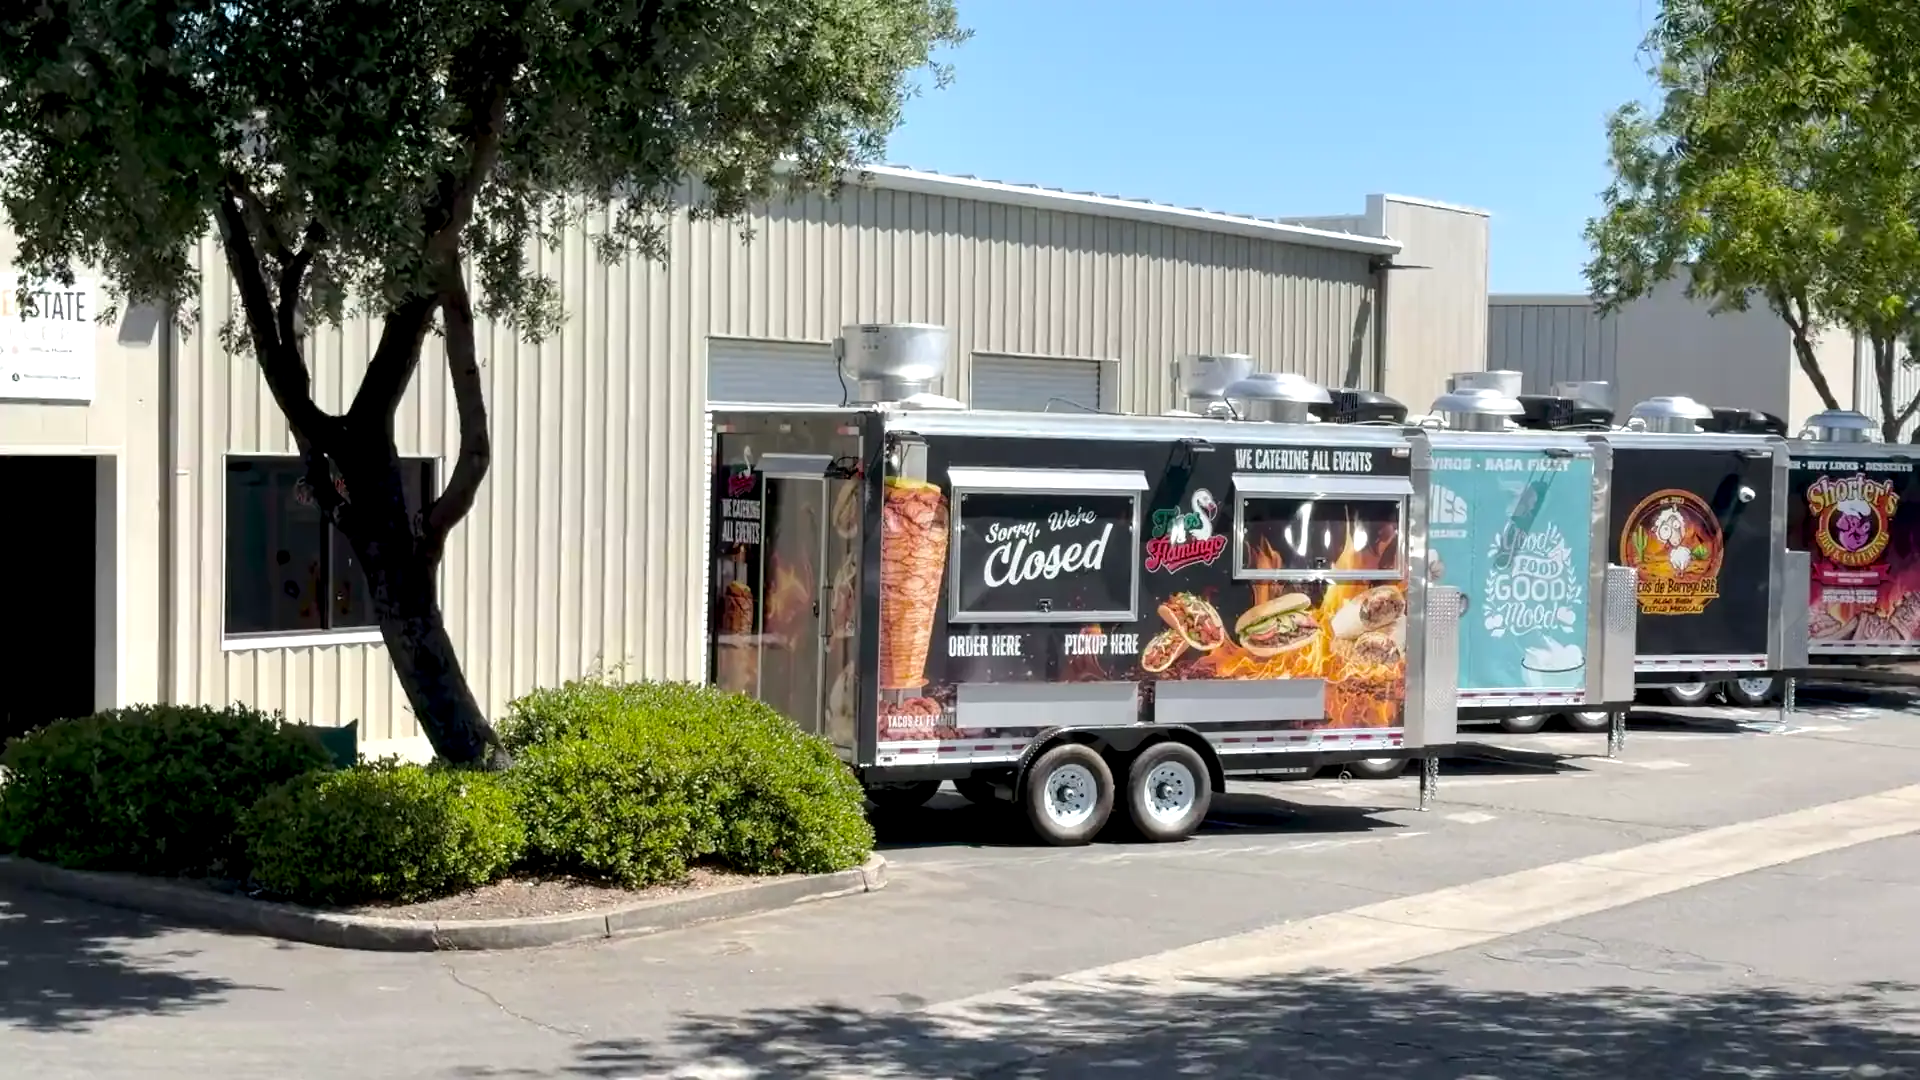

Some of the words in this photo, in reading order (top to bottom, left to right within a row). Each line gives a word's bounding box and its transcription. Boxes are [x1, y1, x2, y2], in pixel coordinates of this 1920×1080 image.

[1235, 448, 1252, 469] WE
[1255, 449, 1309, 470] CATERING
[1311, 450, 1330, 471] ALL
[1332, 451, 1372, 472] EVENTS
[1807, 472, 1900, 517] Shorter's
[722, 520, 734, 542] ALL
[735, 520, 760, 544] EVENTS
[985, 522, 1040, 544] Sorry,
[1047, 507, 1098, 531] We're
[1152, 505, 1203, 538] Tos
[984, 522, 1114, 587] Closed
[1145, 534, 1228, 573] Flamingo
[1494, 519, 1552, 570] Good
[1519, 558, 1560, 576] FOOD
[1495, 574, 1566, 602] GOOD
[1637, 582, 1652, 593] cos
[1654, 578, 1665, 593] de
[1667, 578, 1699, 596] Borrego
[1497, 601, 1558, 635] Mood
[948, 635, 988, 657] ORDER
[991, 634, 1022, 656] HERE
[1064, 633, 1108, 655] PICKUP
[1110, 633, 1139, 655] HERE
[888, 714, 913, 728] TACOS
